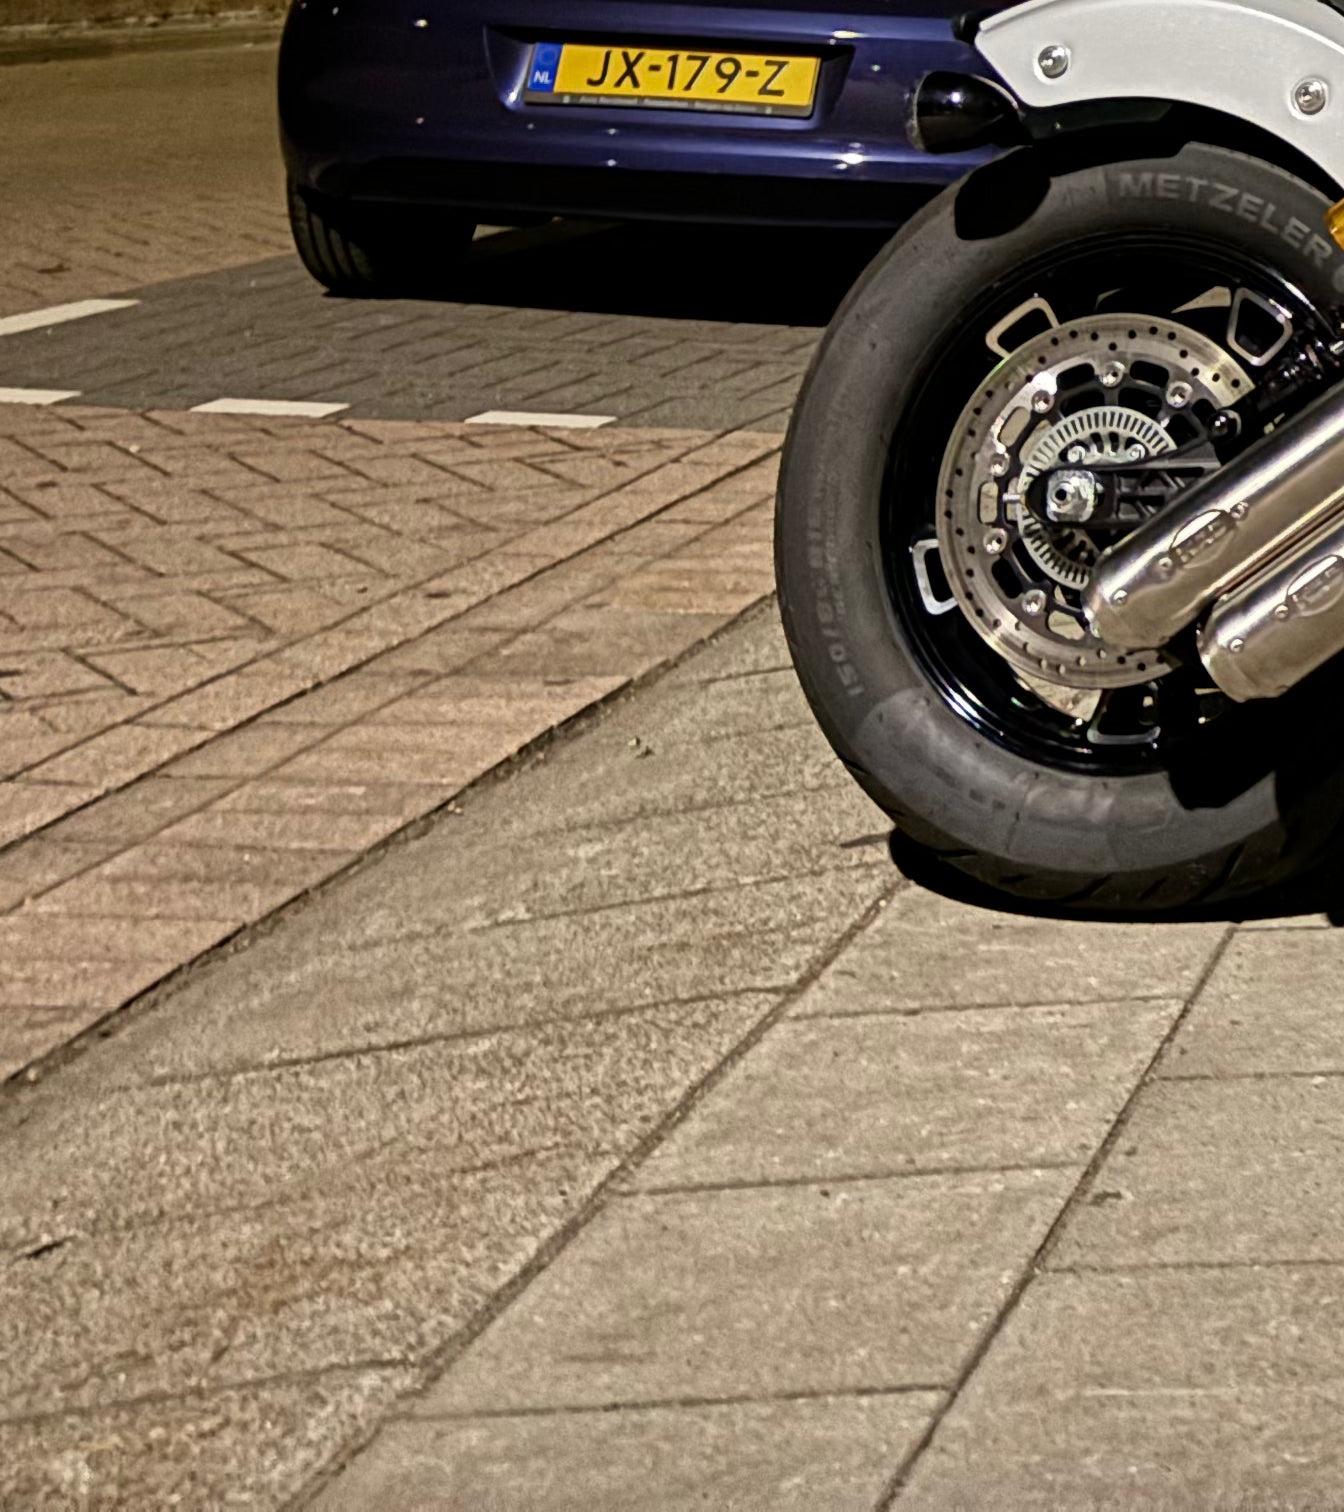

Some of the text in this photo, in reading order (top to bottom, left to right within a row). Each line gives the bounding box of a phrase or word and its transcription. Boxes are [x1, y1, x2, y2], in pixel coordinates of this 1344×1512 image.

[533, 70, 553, 85] NL
[586, 50, 790, 97] JX-179-Z
[1116, 171, 1334, 269] METZELER
